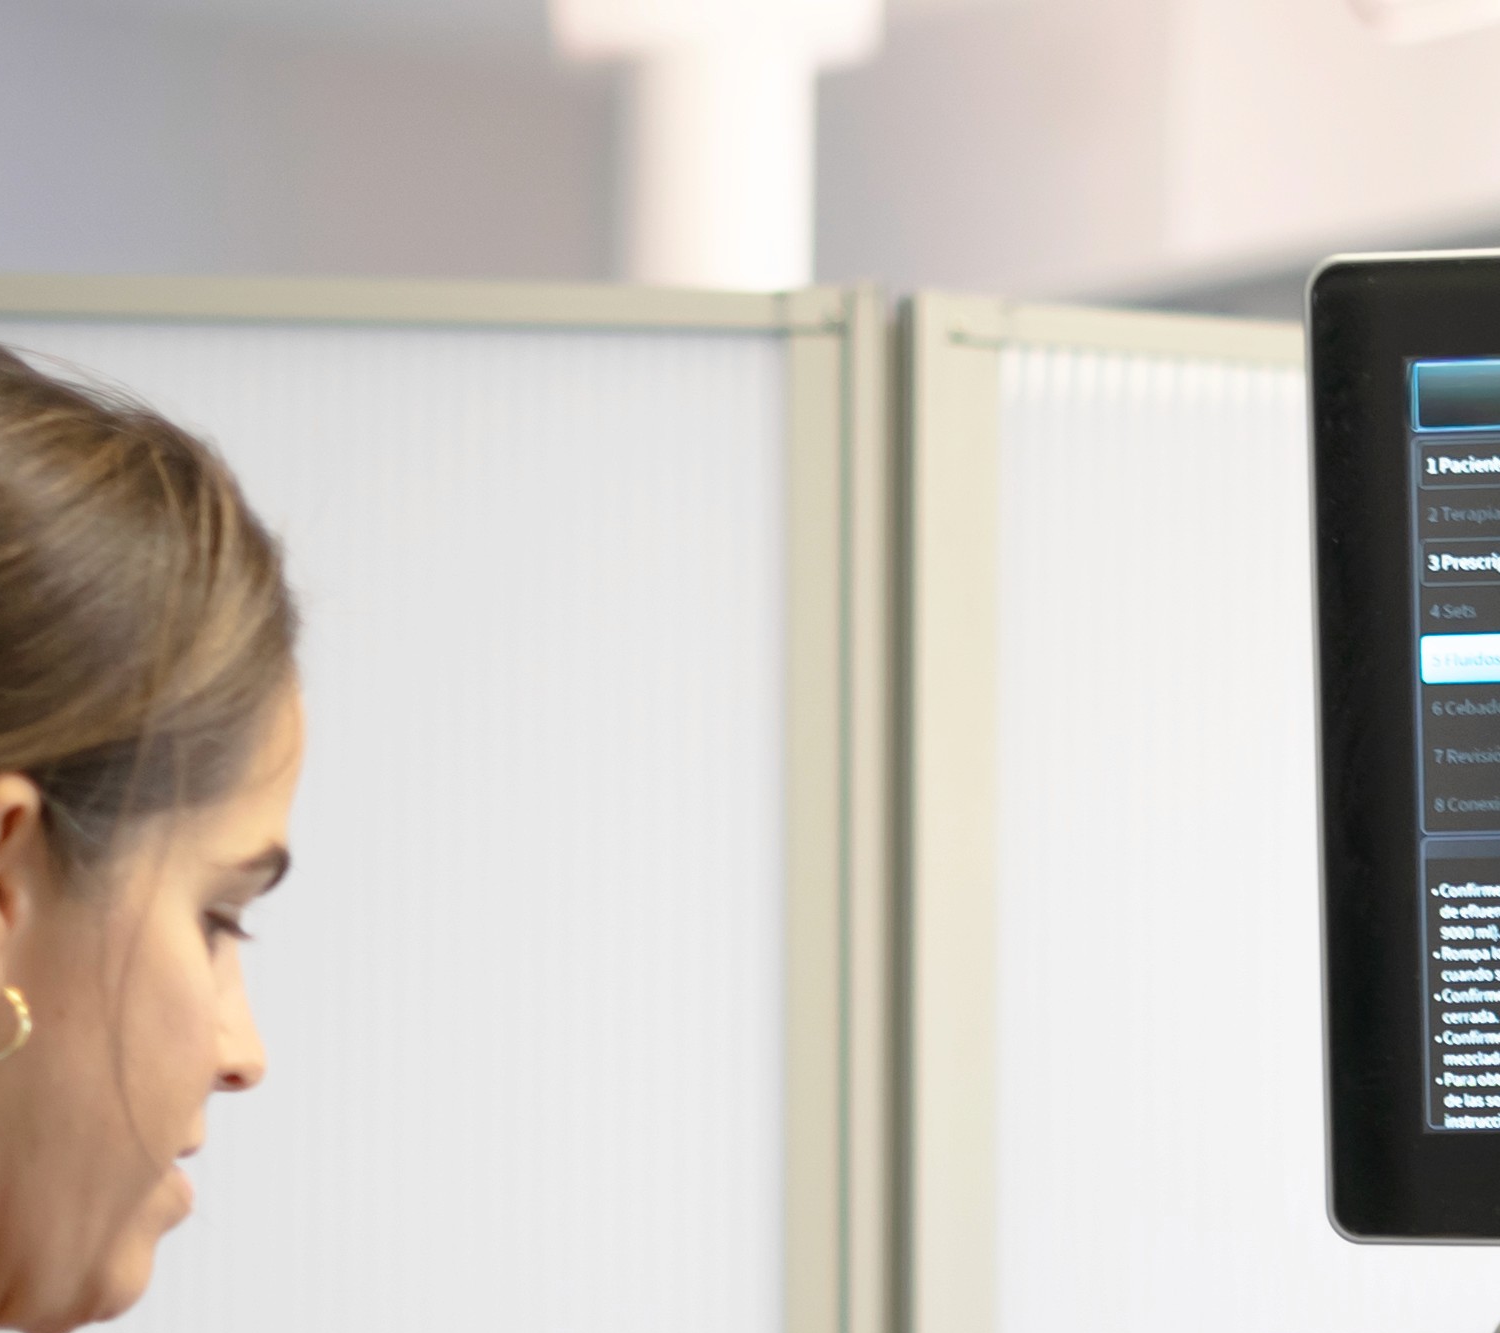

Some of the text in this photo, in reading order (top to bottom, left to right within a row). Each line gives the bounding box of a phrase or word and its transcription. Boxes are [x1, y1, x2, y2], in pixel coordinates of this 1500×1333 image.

[1426, 456, 1438, 474] 1
[1427, 507, 1438, 522] 2
[1427, 554, 1440, 571] 3
[1429, 603, 1477, 619] 4 Sets
[1431, 701, 1443, 716] 6
[1433, 748, 1444, 764] 7
[1434, 797, 1445, 813] 8
[1440, 904, 1459, 919] de
[1441, 945, 1491, 963] Rompa
[1441, 967, 1494, 982] cuando
[1444, 1072, 1477, 1087] Para
[1444, 1094, 1463, 1108] de
[1463, 1093, 1485, 1107] las
